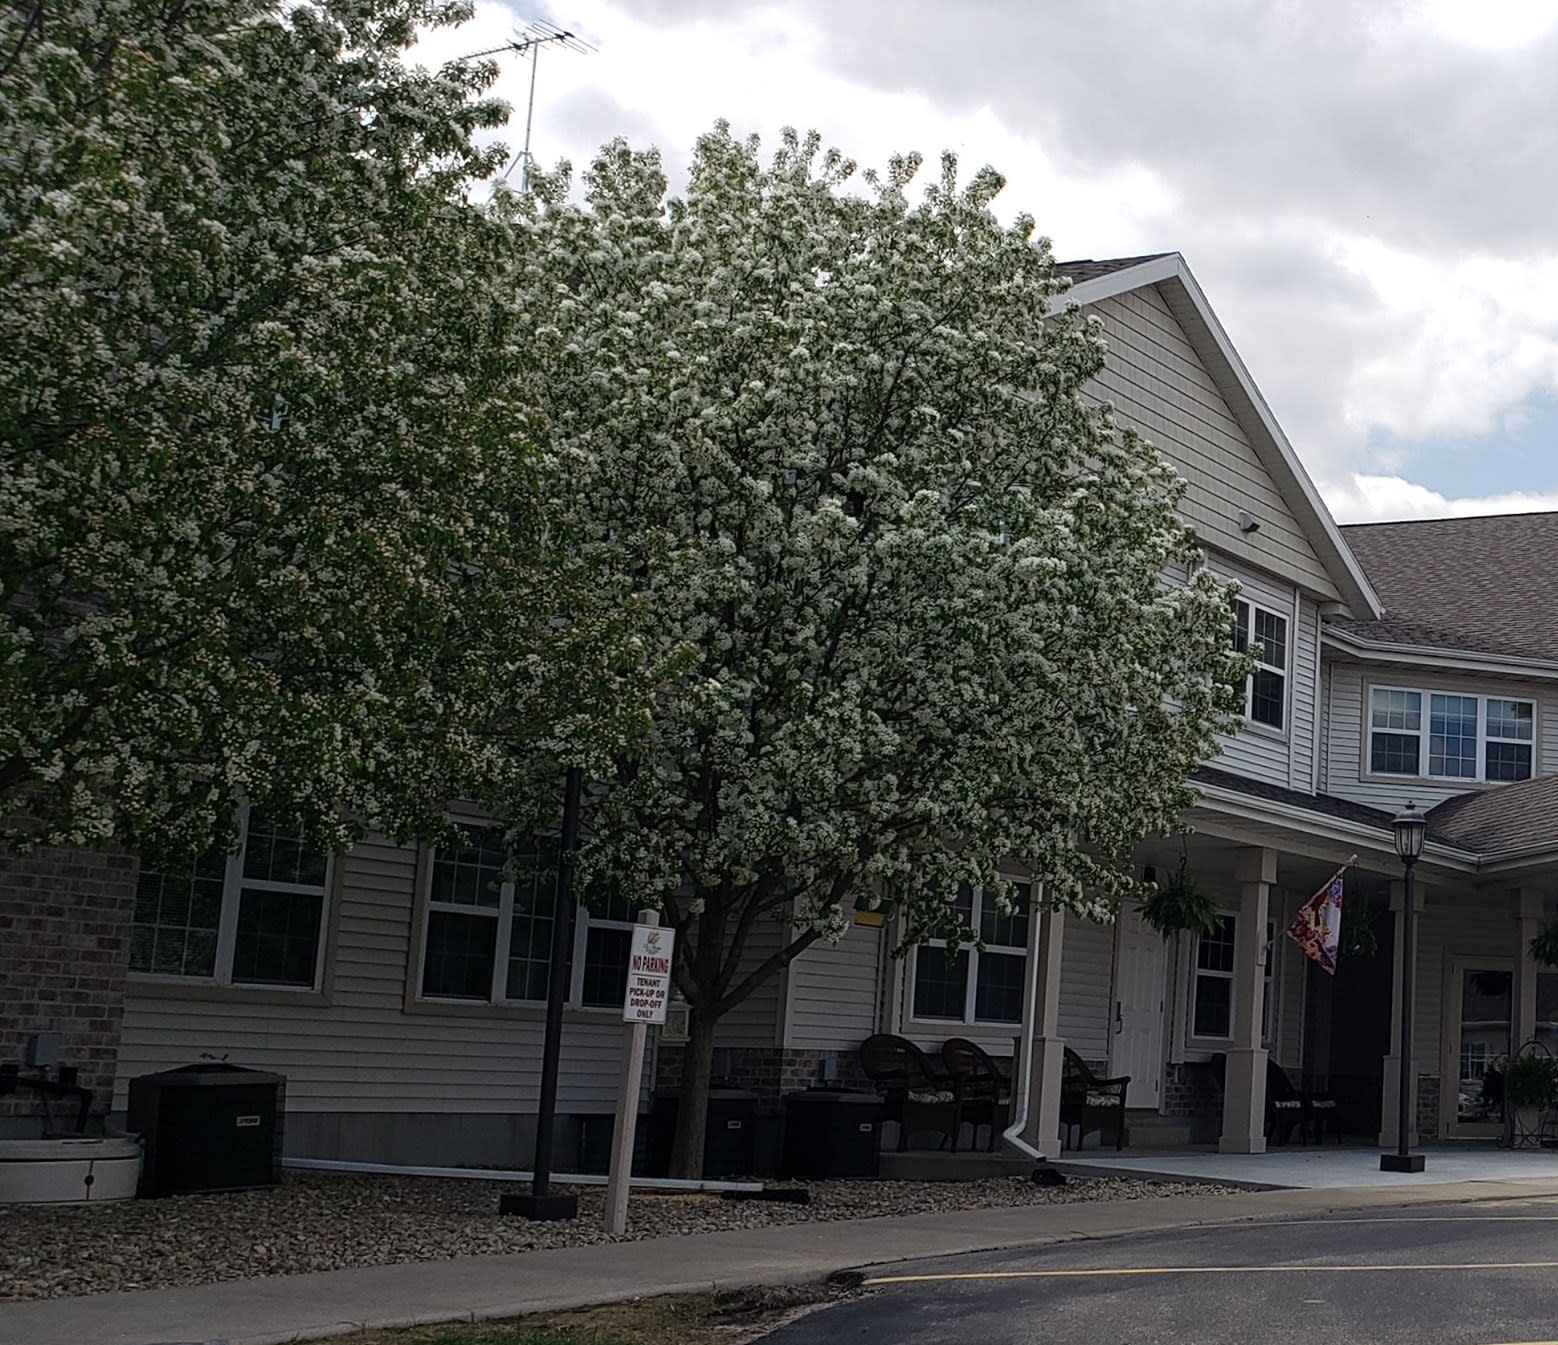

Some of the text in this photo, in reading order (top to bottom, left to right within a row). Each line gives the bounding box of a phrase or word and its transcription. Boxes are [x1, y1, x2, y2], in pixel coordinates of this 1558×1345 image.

[633, 954, 669, 974] NO PARKING
[636, 977, 661, 988] TENANT
[629, 987, 665, 998] PICK-UP OR
[630, 998, 662, 1009] DROP-OFF
[636, 1009, 654, 1018] ONLY
